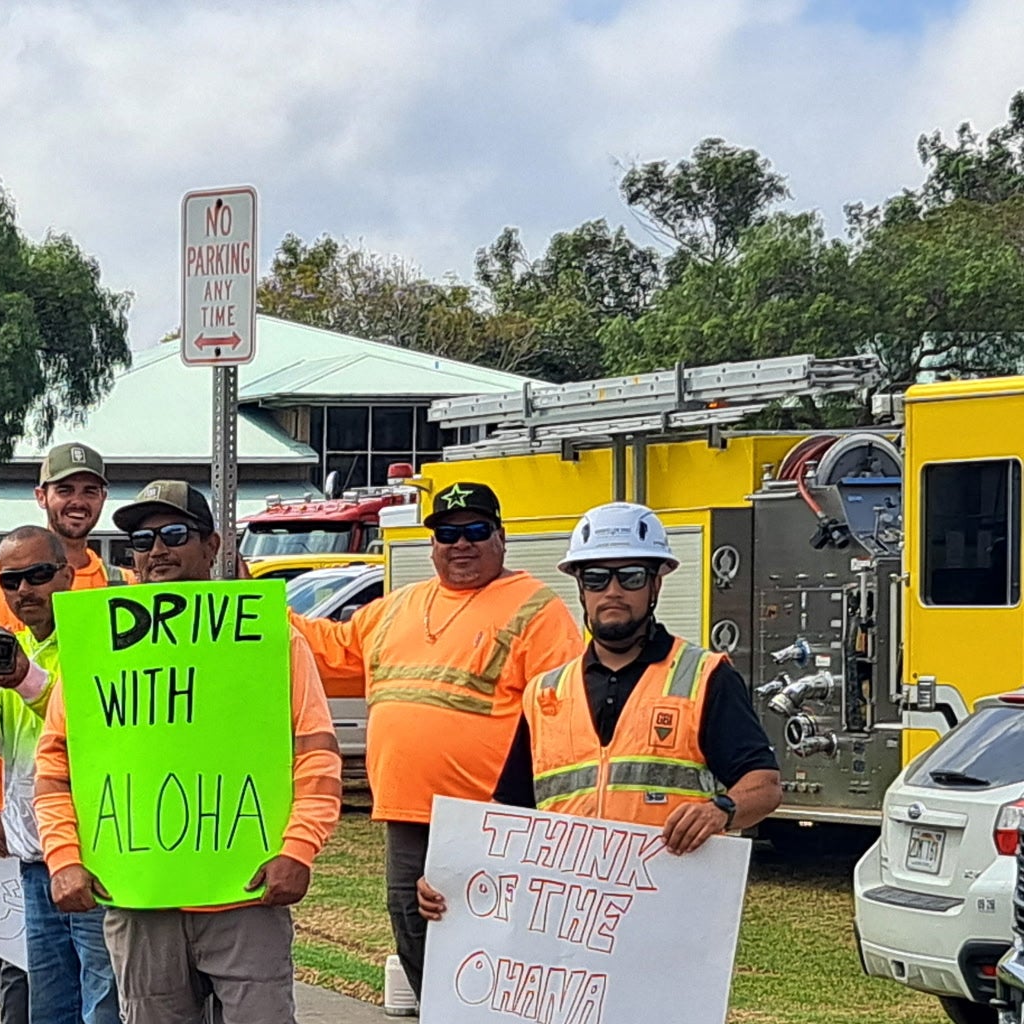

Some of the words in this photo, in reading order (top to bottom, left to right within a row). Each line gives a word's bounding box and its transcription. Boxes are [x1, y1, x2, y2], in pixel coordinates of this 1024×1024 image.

[206, 204, 232, 237] NO
[187, 242, 250, 277] PARKING
[201, 305, 235, 327] TIME
[204, 280, 232, 301] ANY
[109, 592, 263, 651] DRIVE
[94, 667, 195, 727] WITH
[92, 772, 269, 853] ALOHA
[482, 811, 667, 890] THINK
[467, 870, 518, 922] OF
[528, 878, 633, 953] THE
